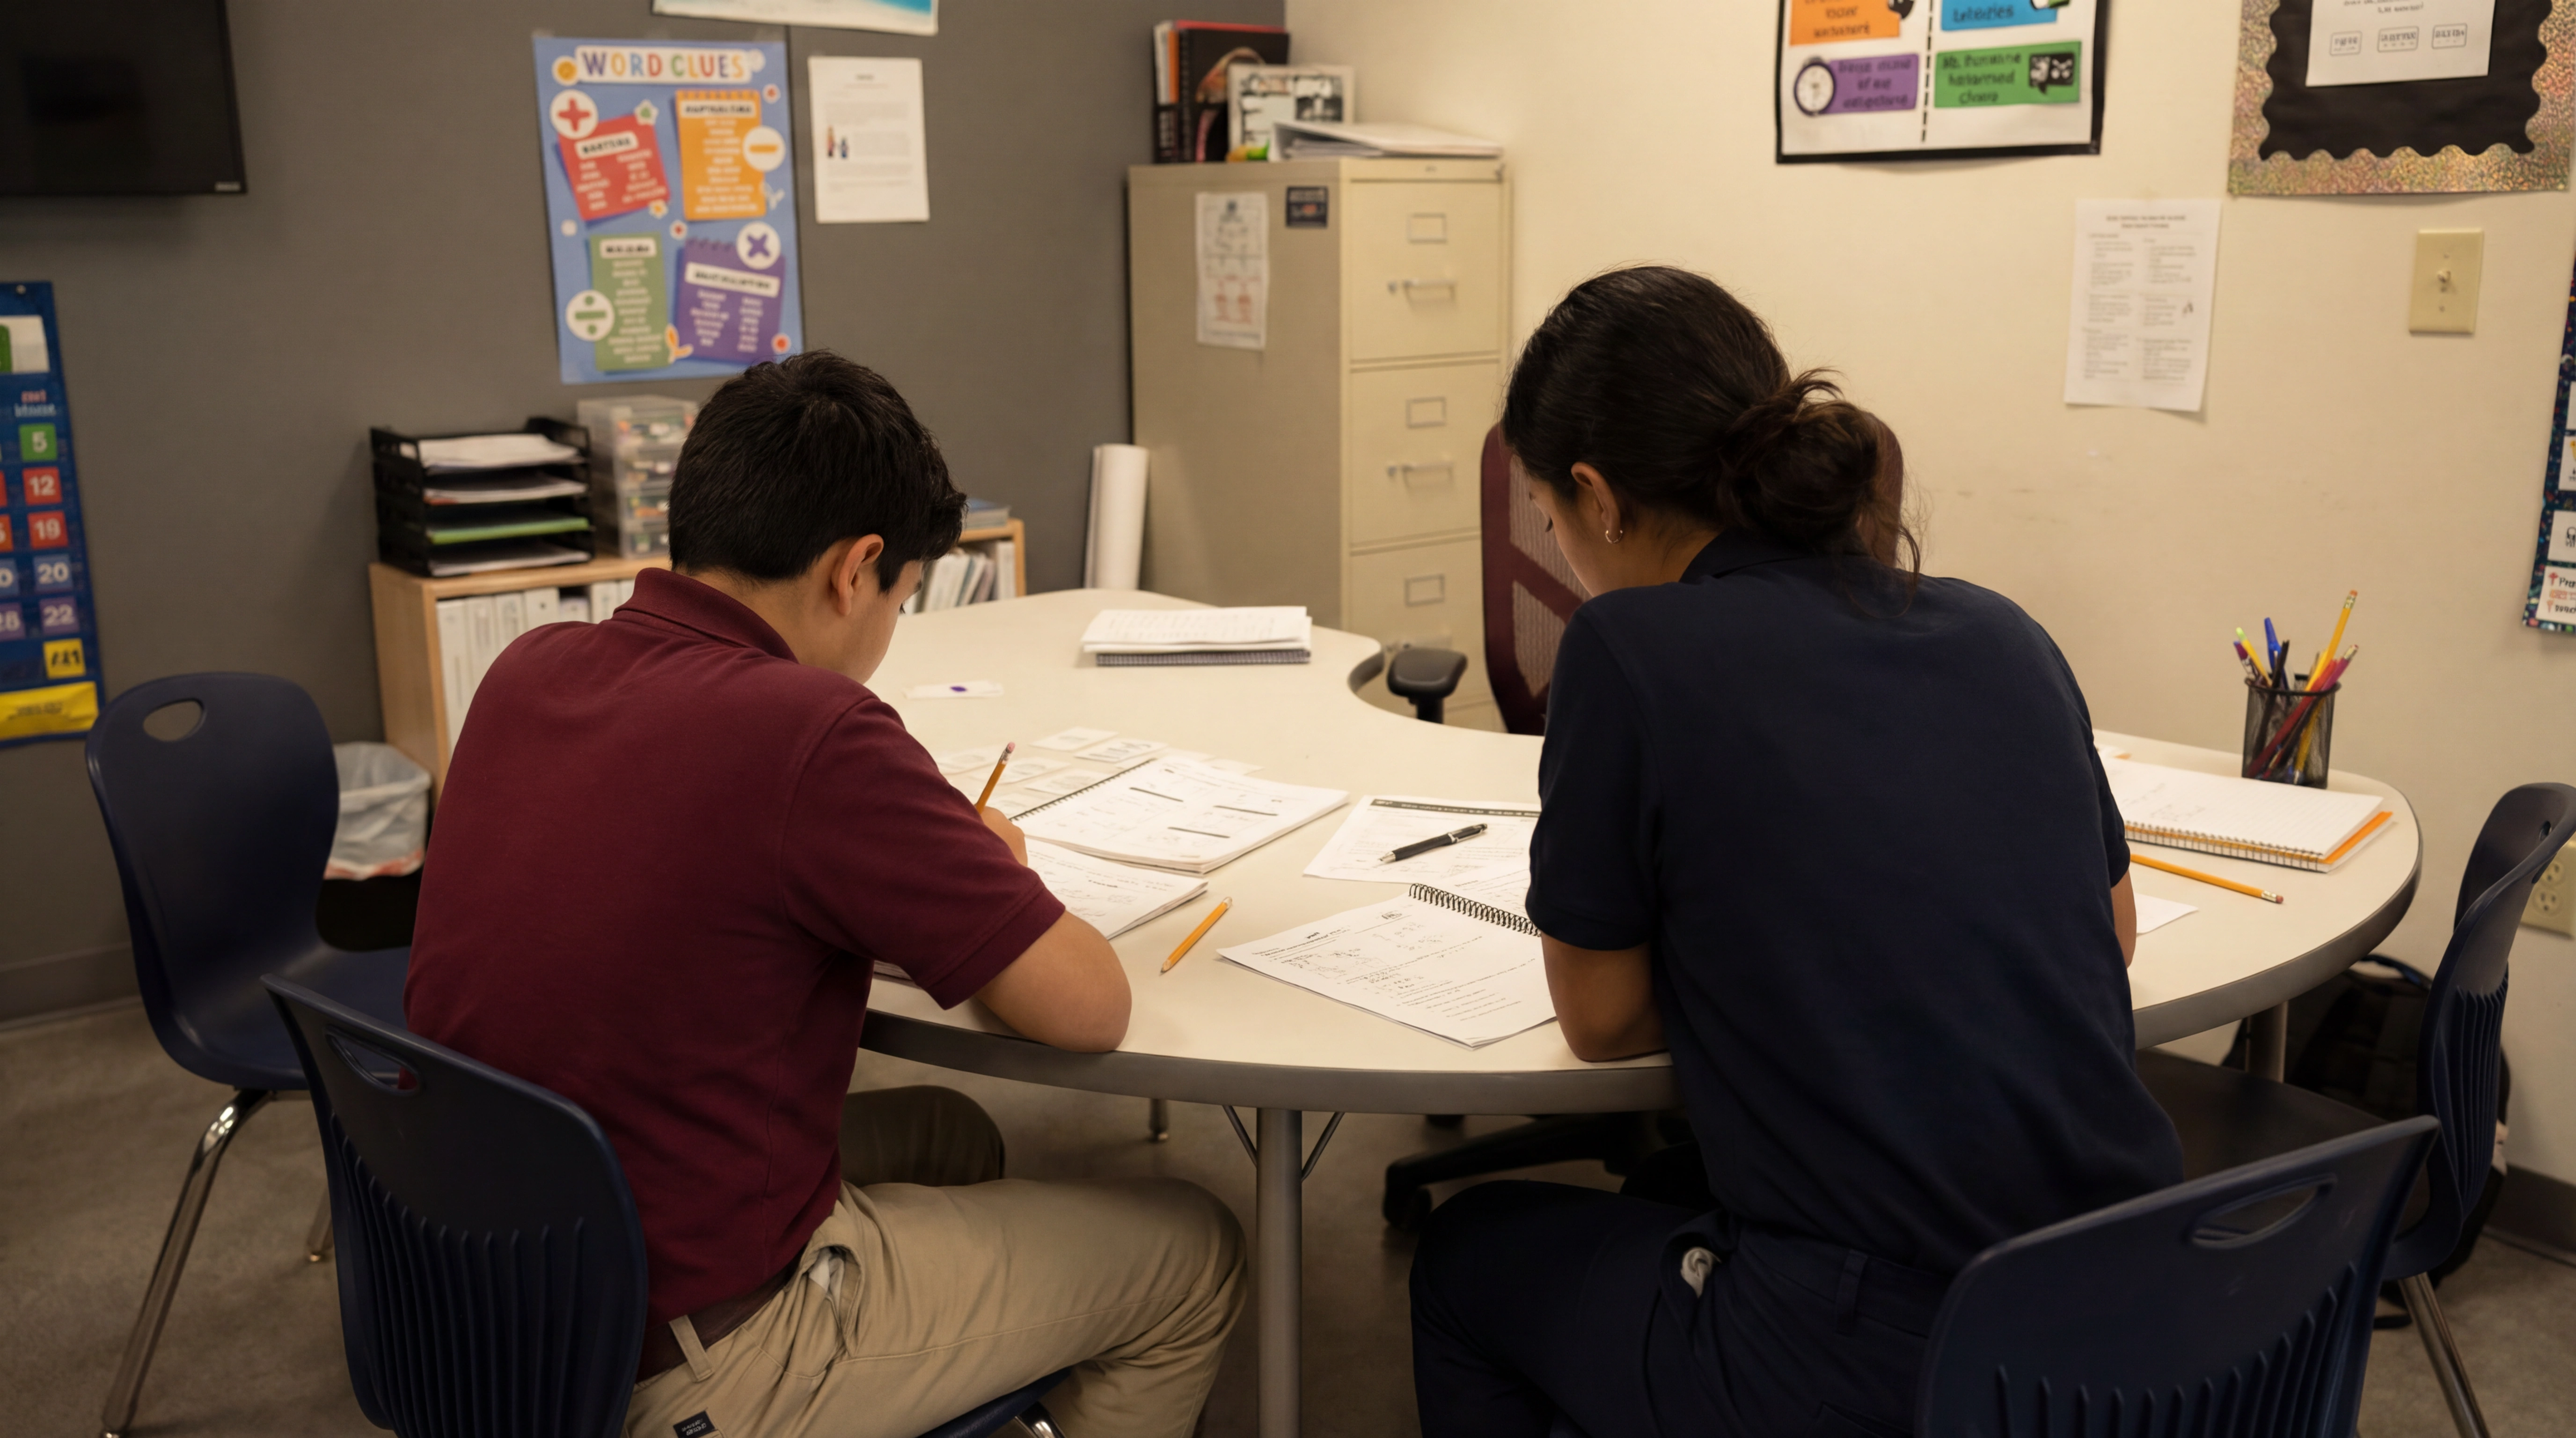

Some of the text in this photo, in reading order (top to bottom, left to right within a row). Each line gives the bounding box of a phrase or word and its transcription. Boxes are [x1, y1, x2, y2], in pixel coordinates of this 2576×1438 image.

[582, 51, 745, 79] WORD CLUES
[32, 431, 48, 453] 5
[29, 474, 56, 496] 12
[35, 518, 61, 540] 19
[37, 562, 69, 584] 20
[44, 604, 74, 627] 22
